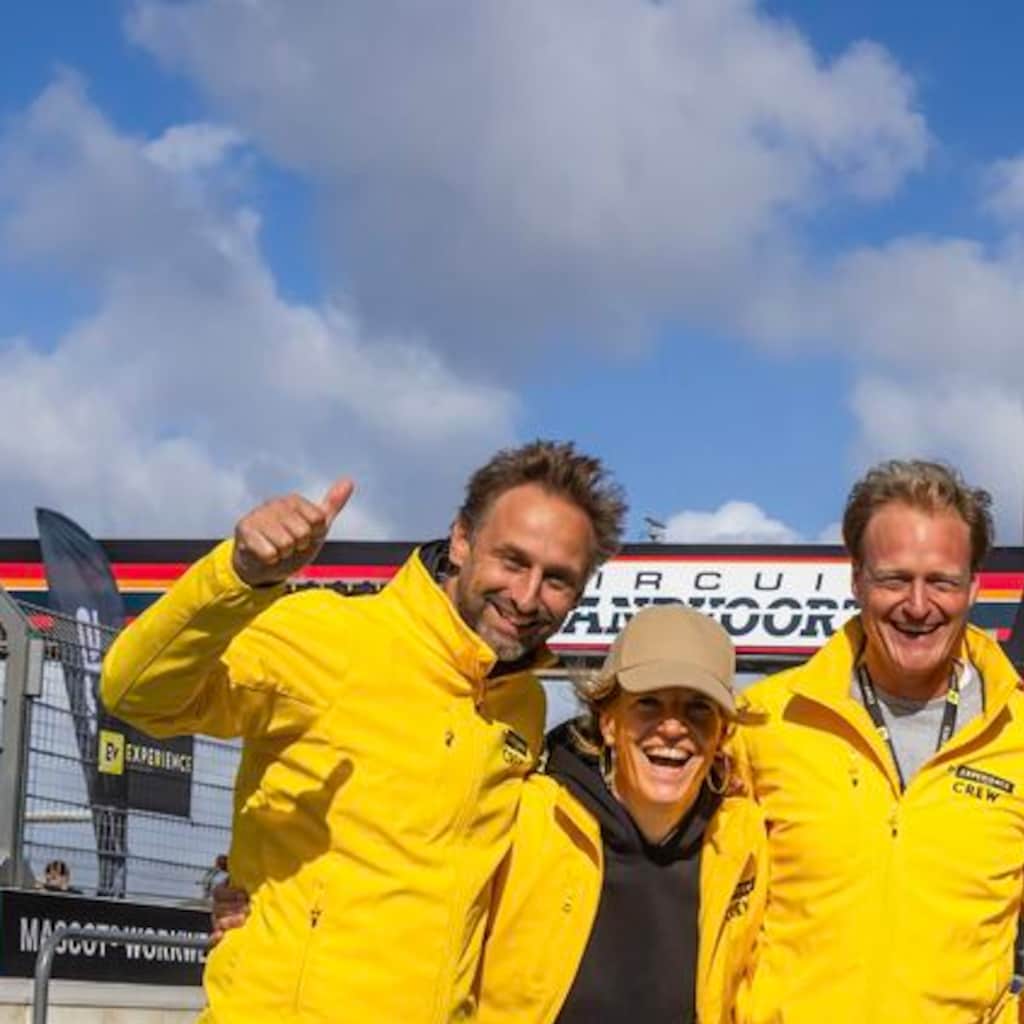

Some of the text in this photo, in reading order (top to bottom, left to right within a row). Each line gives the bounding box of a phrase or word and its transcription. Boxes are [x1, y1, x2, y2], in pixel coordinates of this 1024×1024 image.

[595, 571, 824, 591] IRCUI
[125, 743, 193, 773] EXPERIENCE
[952, 782, 999, 802] CREW
